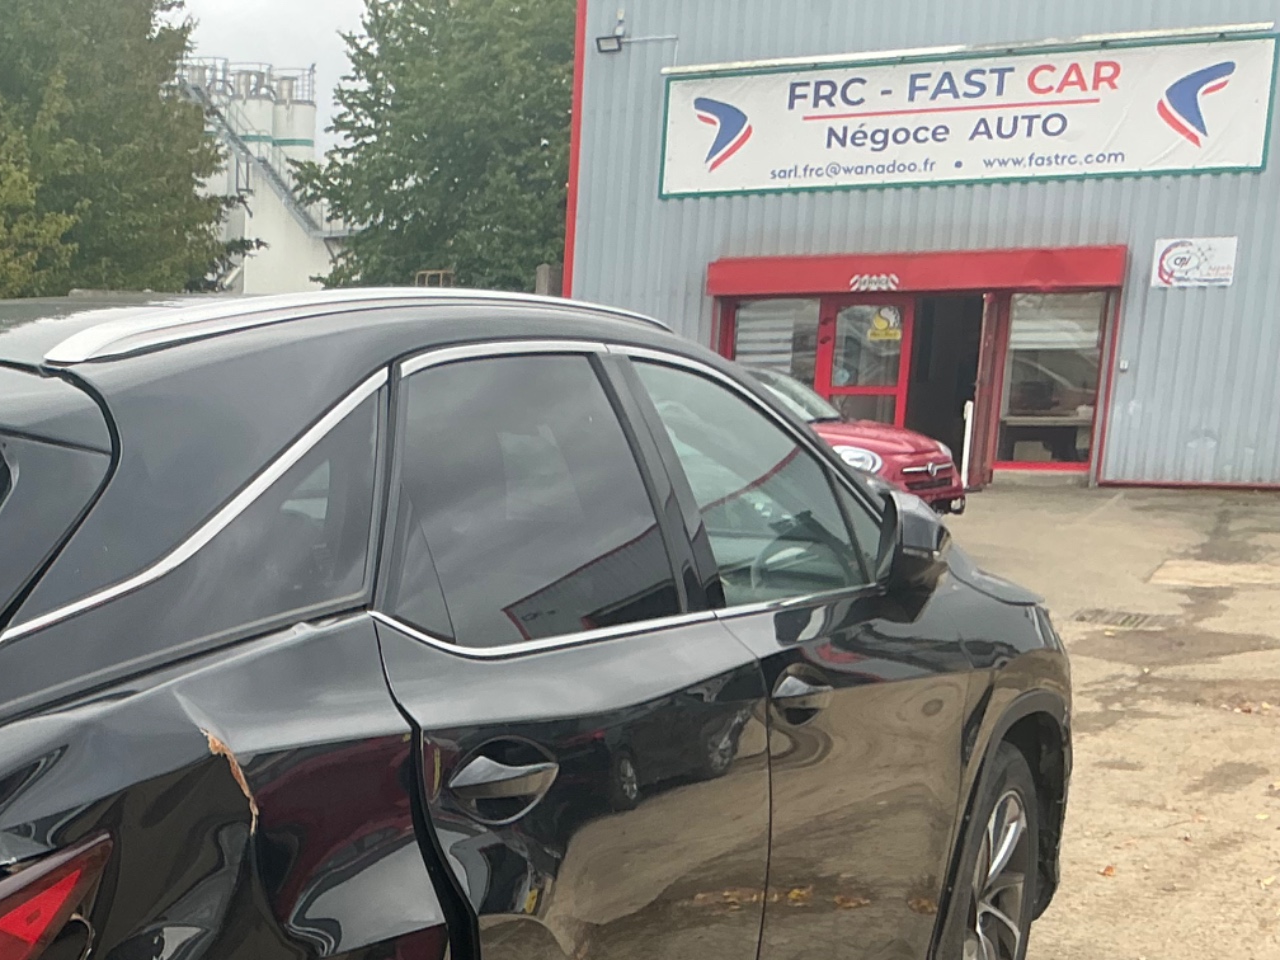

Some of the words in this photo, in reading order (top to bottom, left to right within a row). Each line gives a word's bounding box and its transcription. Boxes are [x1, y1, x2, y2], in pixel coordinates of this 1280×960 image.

[786, 77, 868, 110] FRC
[907, 67, 1015, 103] FAST
[1027, 61, 1122, 95] CAR
[825, 123, 950, 152] Négoce
[969, 113, 1068, 142] AUTO
[770, 159, 936, 180] sarl.frc@wanadoo.fr
[982, 150, 1125, 170] www.fastrc.com
